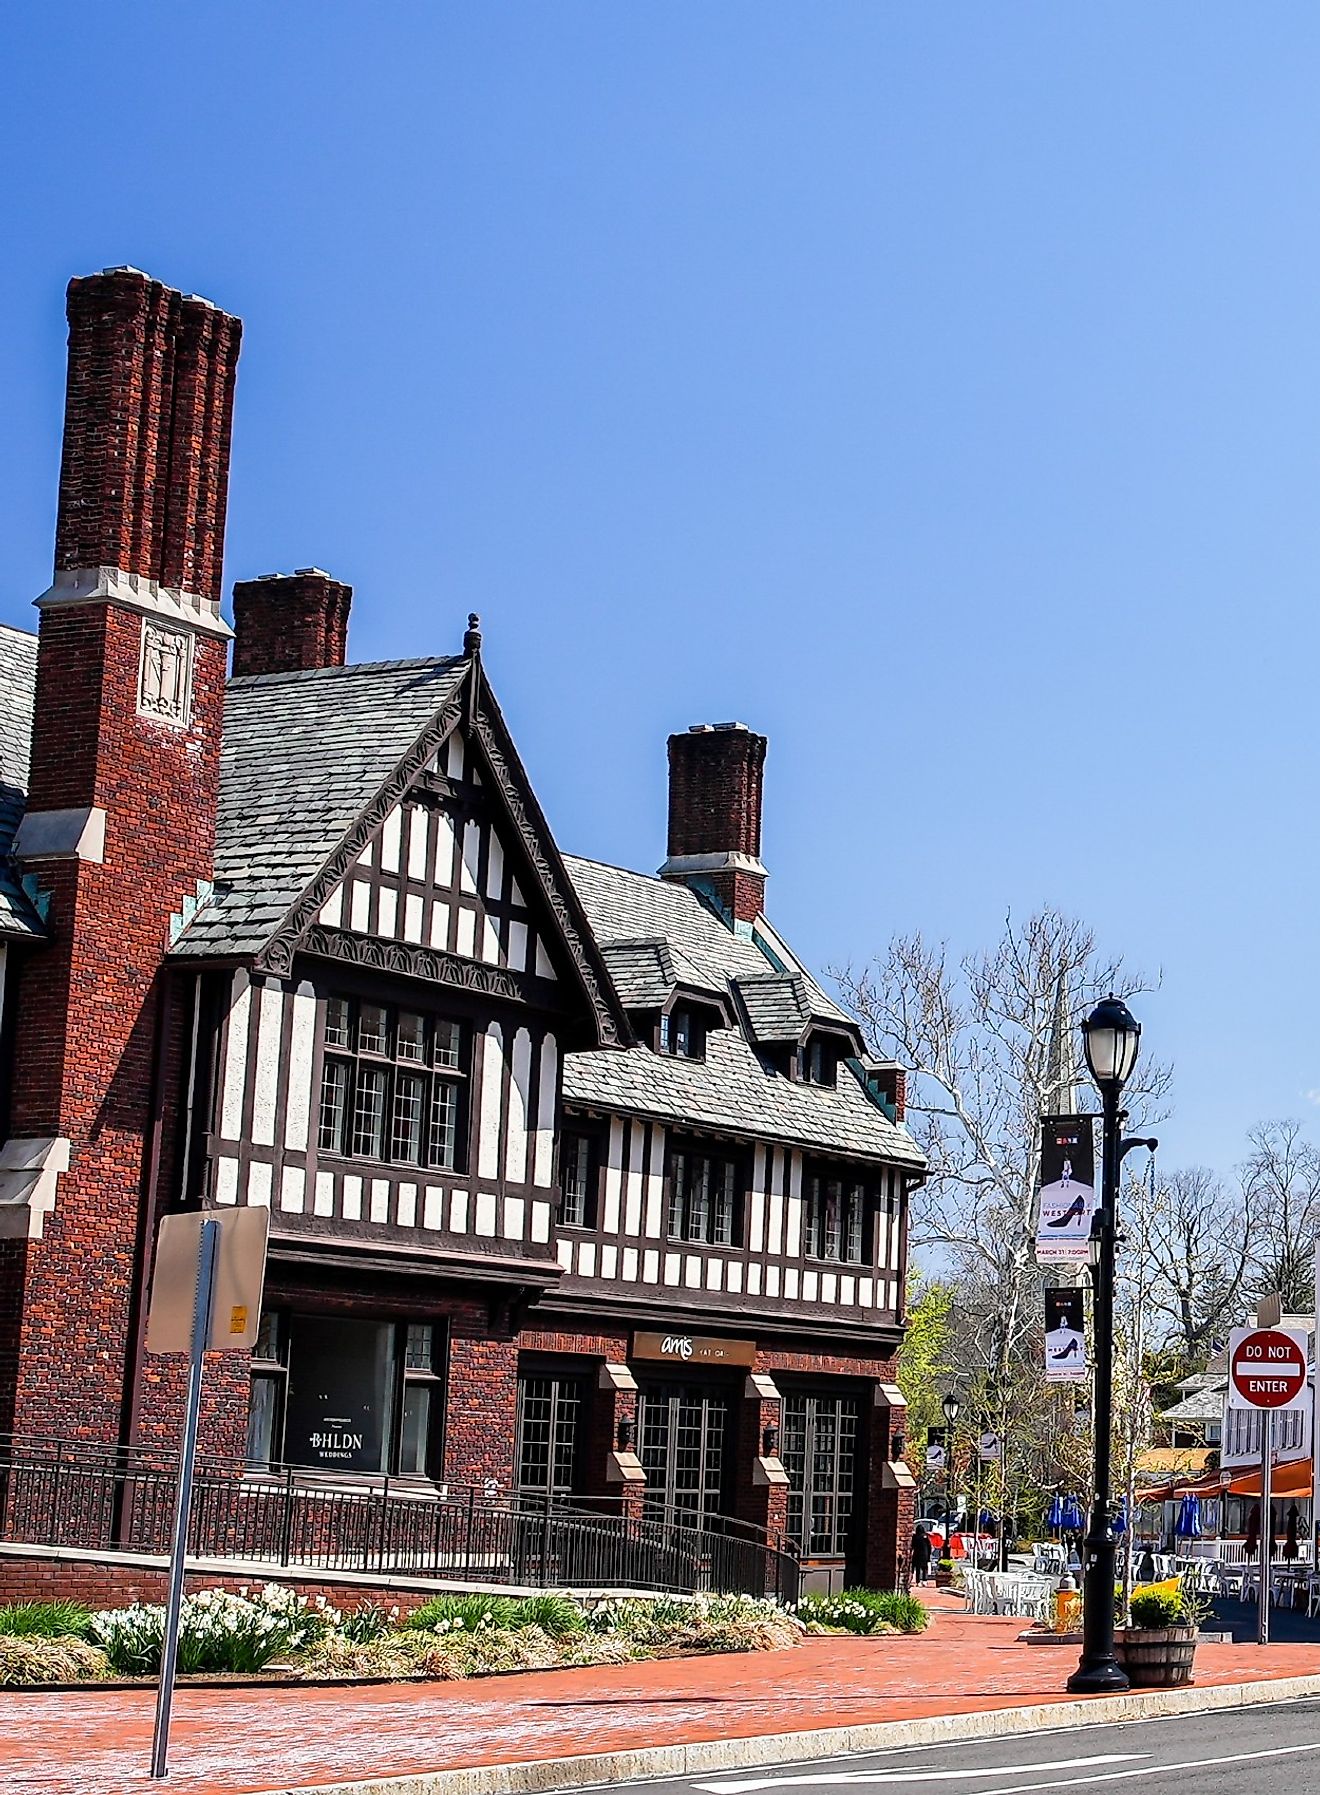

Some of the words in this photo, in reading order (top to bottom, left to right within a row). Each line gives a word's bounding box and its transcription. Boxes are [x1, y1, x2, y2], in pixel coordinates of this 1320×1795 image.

[1042, 1209, 1092, 1217] WESTORT
[661, 1336, 692, 1360] amis
[1246, 1345, 1262, 1358] DO
[1268, 1346, 1292, 1359] NOT
[1249, 1380, 1288, 1393] ENTER
[309, 1432, 362, 1449] BHLDN
[319, 1451, 352, 1459] WEDDINGS
